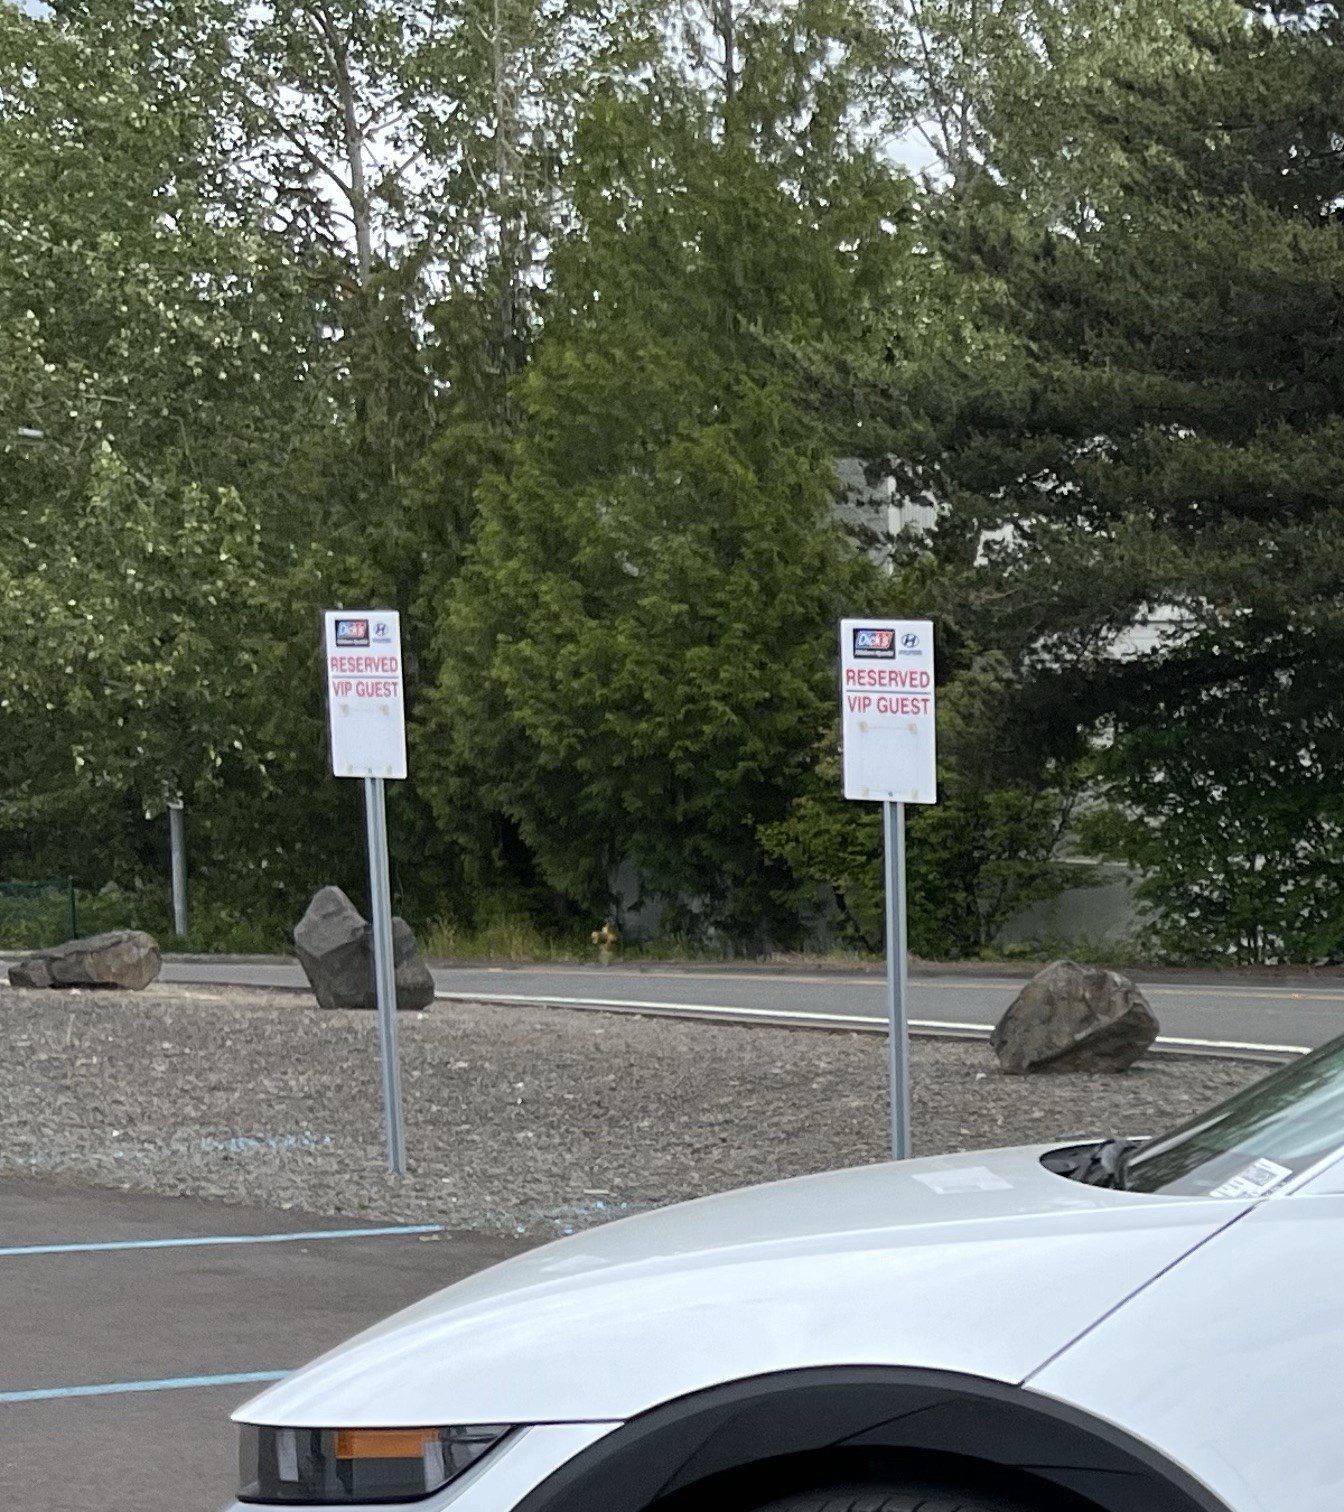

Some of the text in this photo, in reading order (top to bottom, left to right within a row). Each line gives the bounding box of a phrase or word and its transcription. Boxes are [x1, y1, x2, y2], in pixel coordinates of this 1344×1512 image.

[330, 656, 399, 673] RESERVED
[846, 669, 930, 689] RESERVED
[333, 681, 399, 698] VIP GUEST
[848, 696, 930, 716] VIP GUEST
